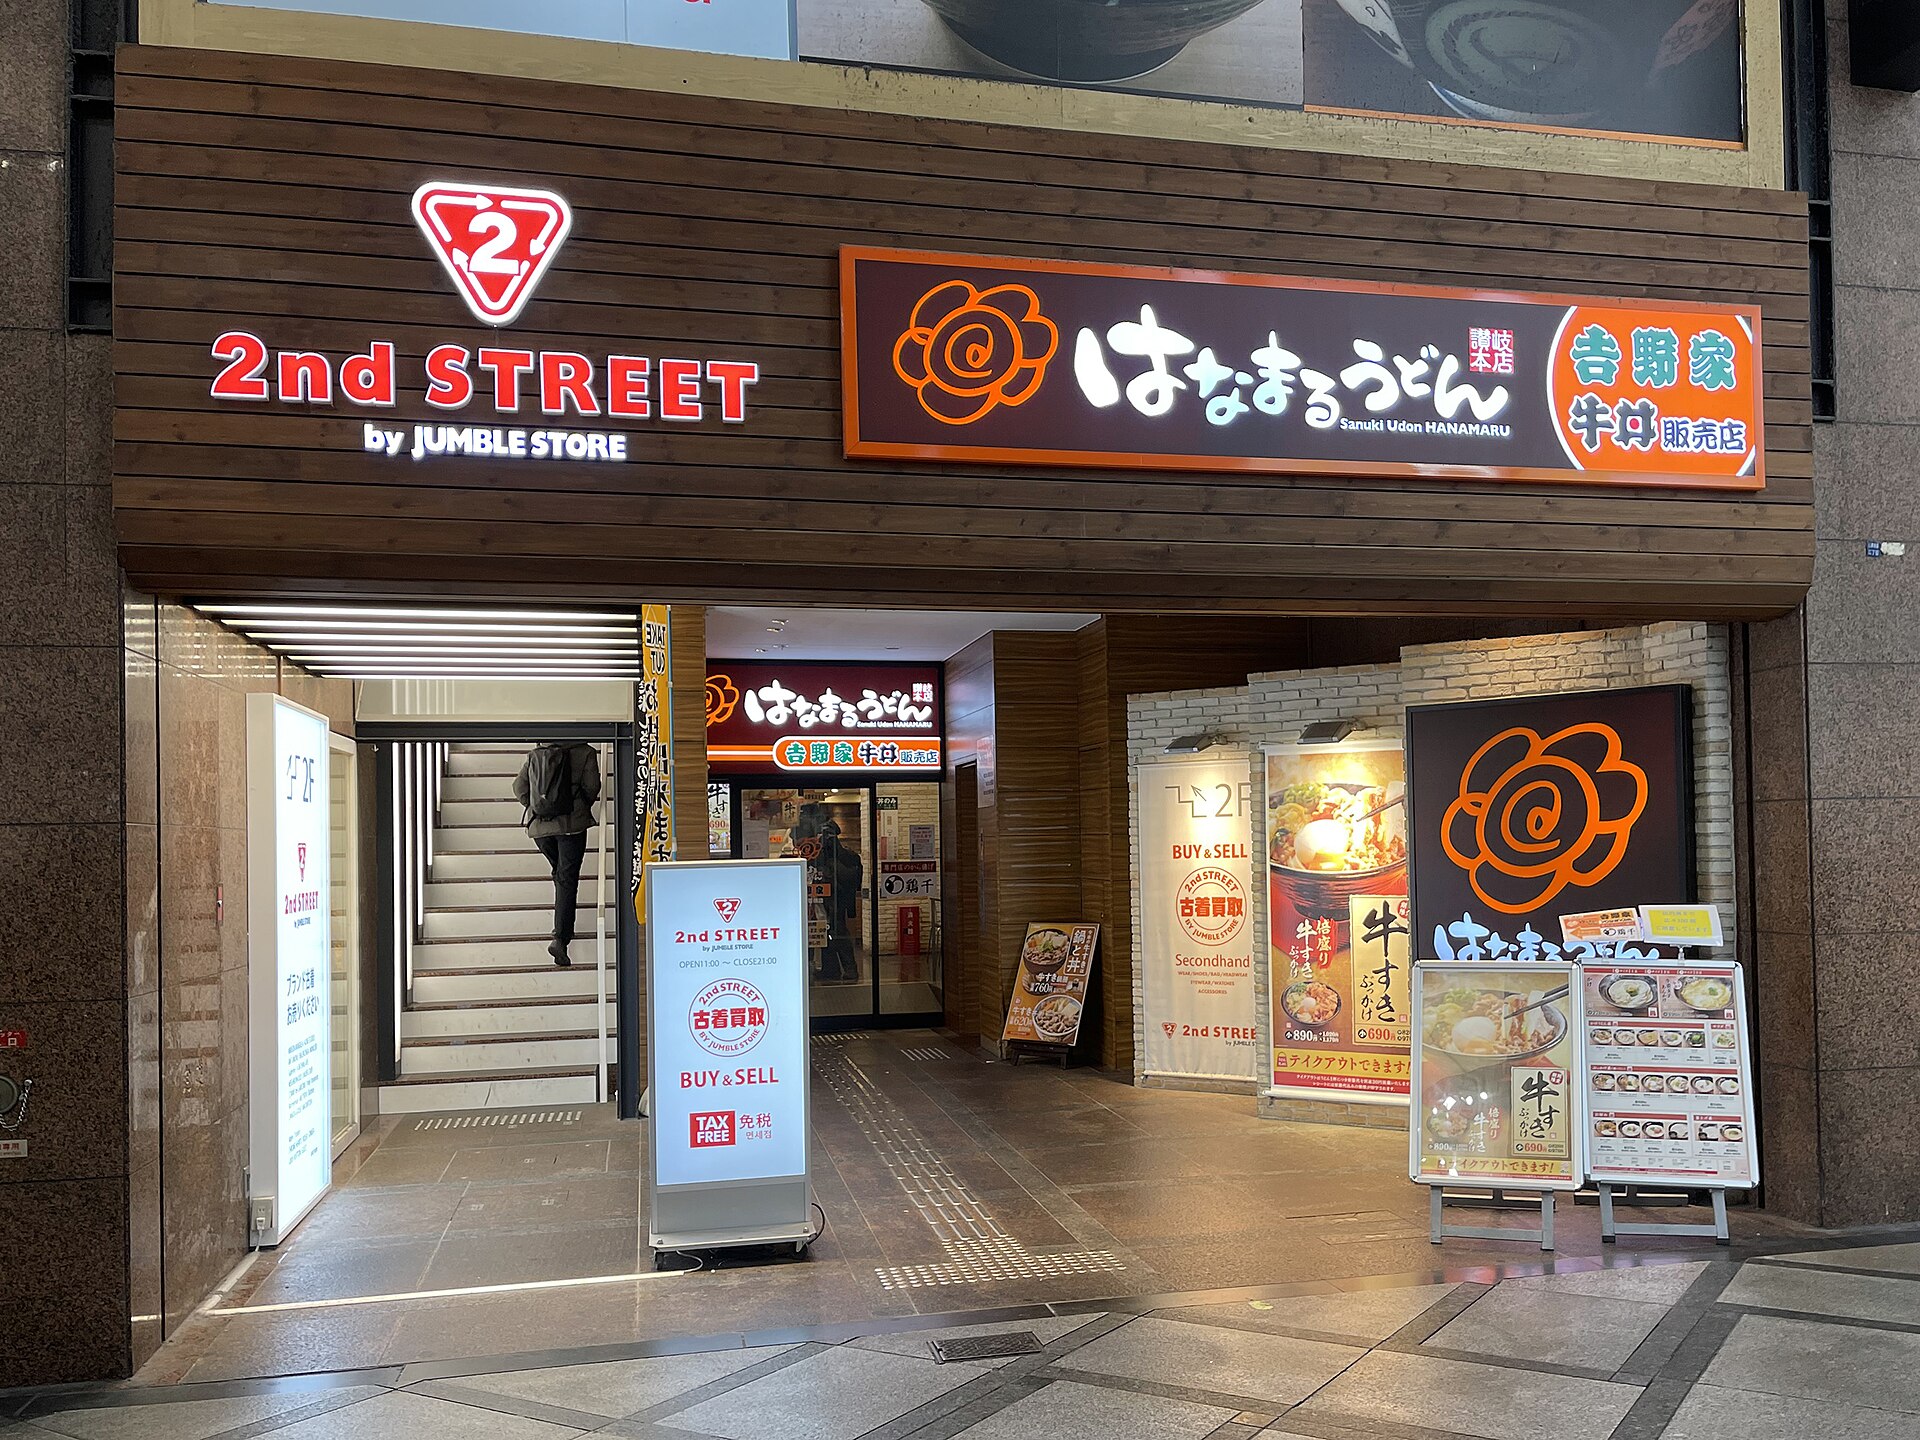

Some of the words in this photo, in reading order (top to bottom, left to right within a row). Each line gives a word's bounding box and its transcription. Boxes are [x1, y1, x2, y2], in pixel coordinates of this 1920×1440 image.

[468, 212, 519, 275] 2
[1075, 303, 1508, 428] はなまるうどん
[1469, 350, 1513, 374] 本店
[1569, 324, 1738, 392] 吉野家
[210, 331, 395, 407] 2nd
[424, 344, 759, 422] STREET
[1339, 417, 1384, 433] Sanuki
[1387, 420, 1422, 434] Udon
[1424, 422, 1511, 437] HANAMARU
[1568, 392, 1659, 453] 牛丼
[1661, 417, 1746, 453] 販売店
[364, 424, 404, 457] by
[411, 425, 526, 461] JUMBLE
[530, 430, 627, 460] STORE
[744, 679, 932, 728] はなまるうどん
[785, 741, 854, 764] 吉野家
[858, 741, 899, 766] 牛丼
[900, 750, 939, 765] 販売店
[303, 756, 315, 803] 2F
[1215, 782, 1251, 818] 2F
[1172, 845, 1202, 860] BUY
[1204, 849, 1212, 859] &
[1214, 843, 1248, 859] SELL
[1184, 873, 1202, 893] 2nd
[1201, 871, 1239, 892] STREET
[285, 893, 298, 914] 2nd
[298, 890, 319, 912] STREET
[1179, 896, 1244, 918] 古着買取
[675, 930, 709, 944] 2nd
[714, 927, 780, 943] STREET
[1192, 928, 1220, 941] JUMBLE
[1218, 918, 1239, 939] STORE
[734, 943, 753, 951] STORE
[1296, 919, 1317, 979] 牛すき
[1316, 918, 1332, 966] 倍盛り
[679, 958, 720, 969] OPEN11:00
[733, 956, 777, 968] CLOSE21:00
[1175, 954, 1250, 968] Secondhand
[1289, 945, 1299, 978] ぶっかけ
[1360, 900, 1409, 1022] 牛すき
[698, 984, 720, 1006] 2nd
[719, 982, 761, 1004] STREET
[1360, 975, 1375, 1022] ぶっかけ
[693, 1007, 766, 1030] 古着買取
[698, 1031, 709, 1046] BY
[708, 1040, 739, 1052] JUMBLE
[738, 1028, 761, 1049] STORE
[1182, 1025, 1209, 1037] 2nd
[680, 1070, 720, 1089] BUY
[722, 1074, 732, 1087] &
[735, 1067, 779, 1085] SELL
[1520, 1071, 1560, 1139] 牛すき
[695, 1115, 729, 1130] TAX
[739, 1112, 772, 1129] 免税
[1519, 1107, 1530, 1138] ぶっかけ
[696, 1128, 730, 1143] FREE
[746, 1129, 773, 1140] 면세점
